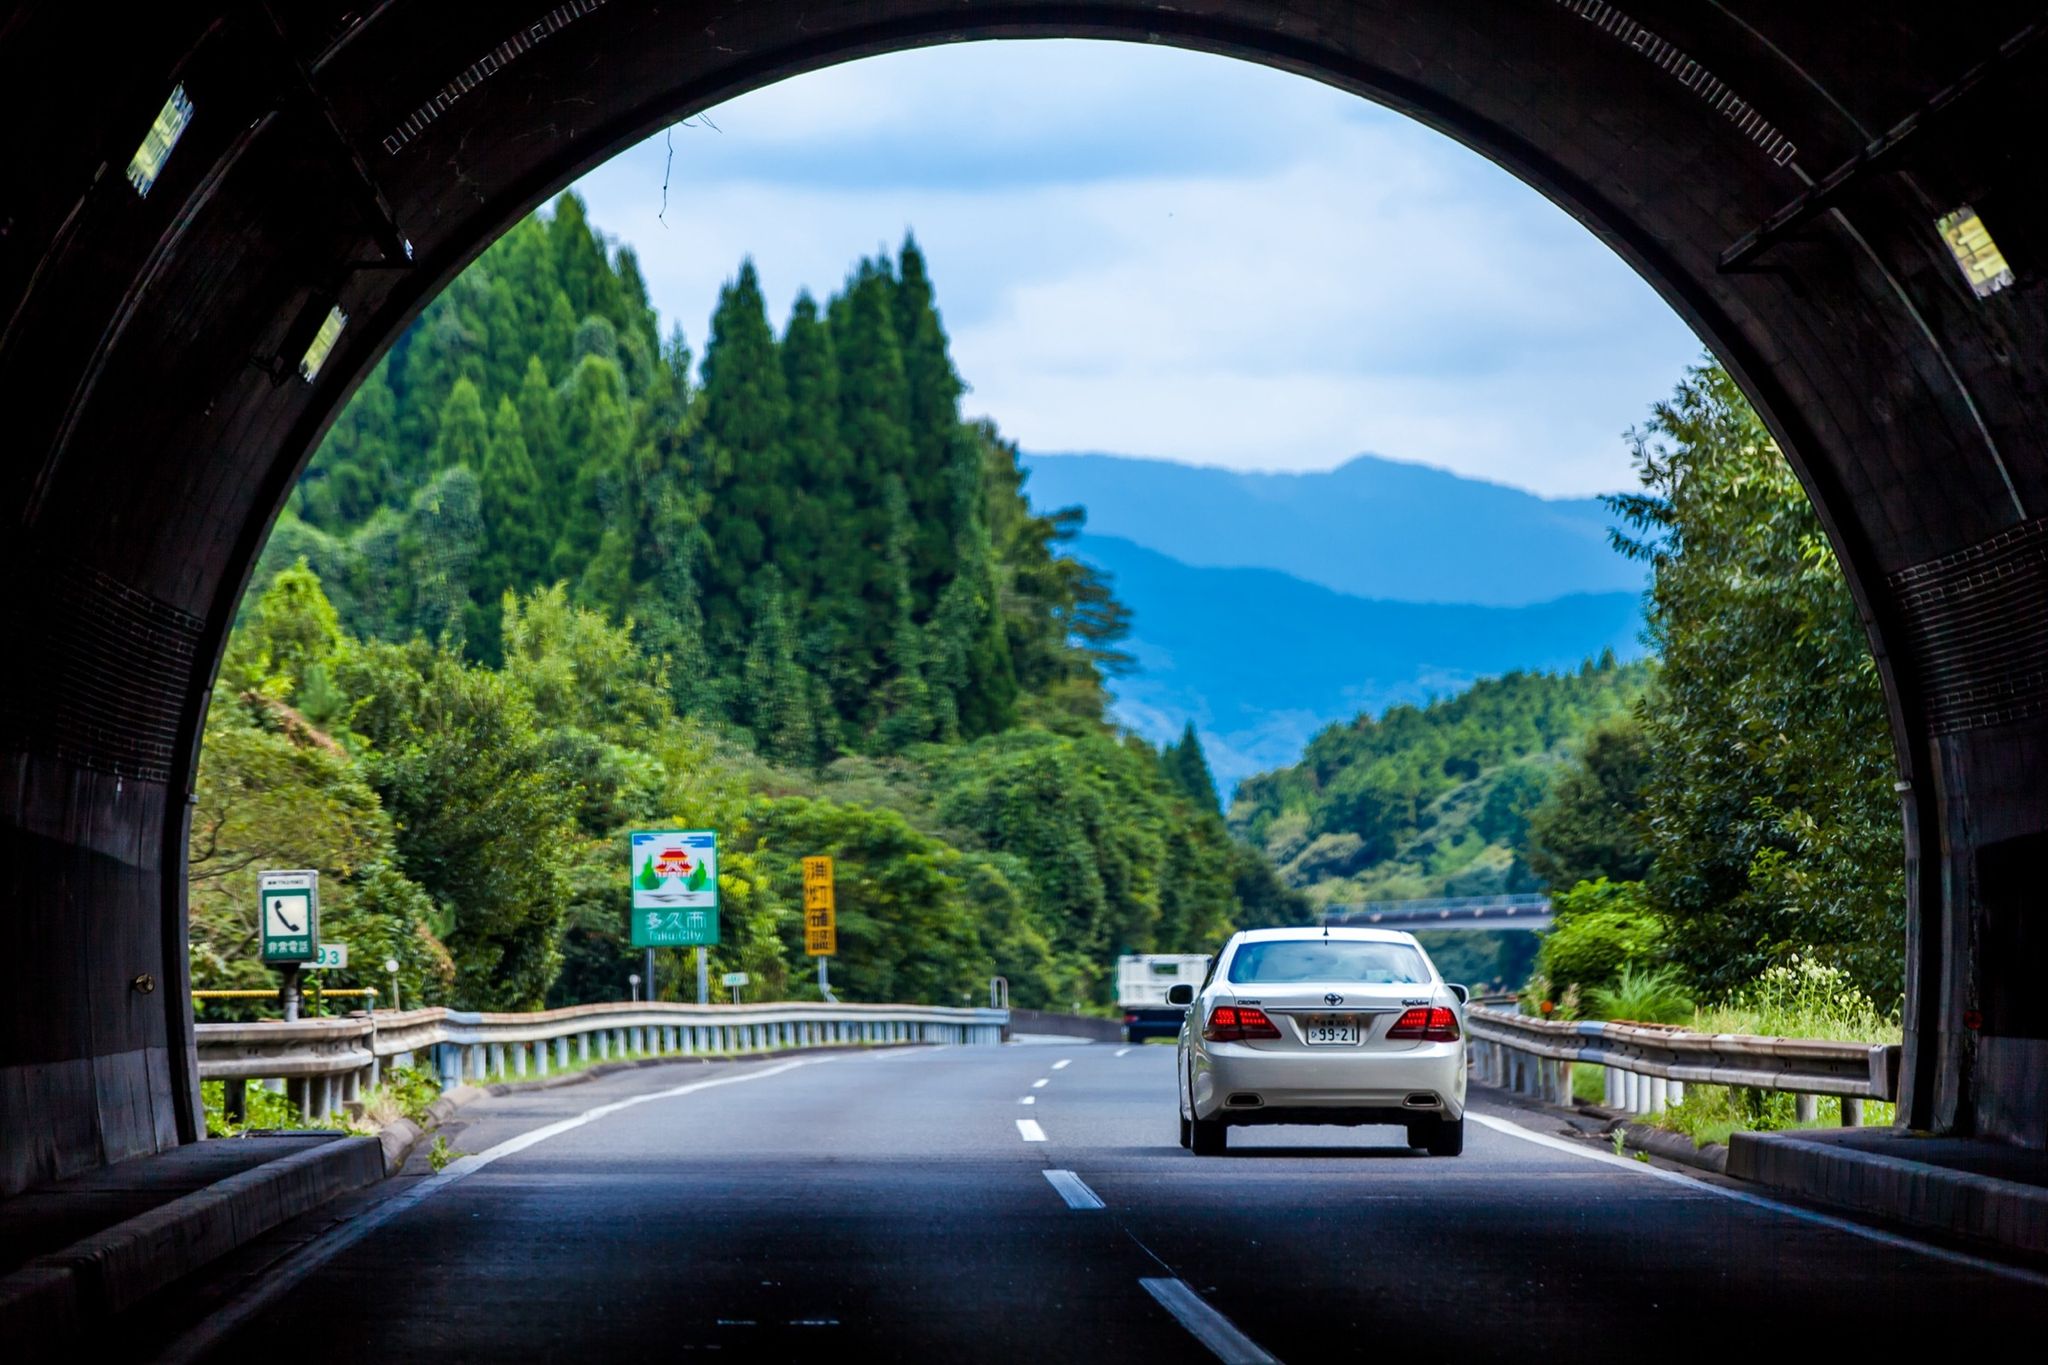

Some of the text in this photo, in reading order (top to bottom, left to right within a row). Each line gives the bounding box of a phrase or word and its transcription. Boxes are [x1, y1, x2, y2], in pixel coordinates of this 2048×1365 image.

[647, 911, 707, 929] 多久市
[649, 931, 704, 942] Taku City
[1319, 1028, 1355, 1041] 99-21
